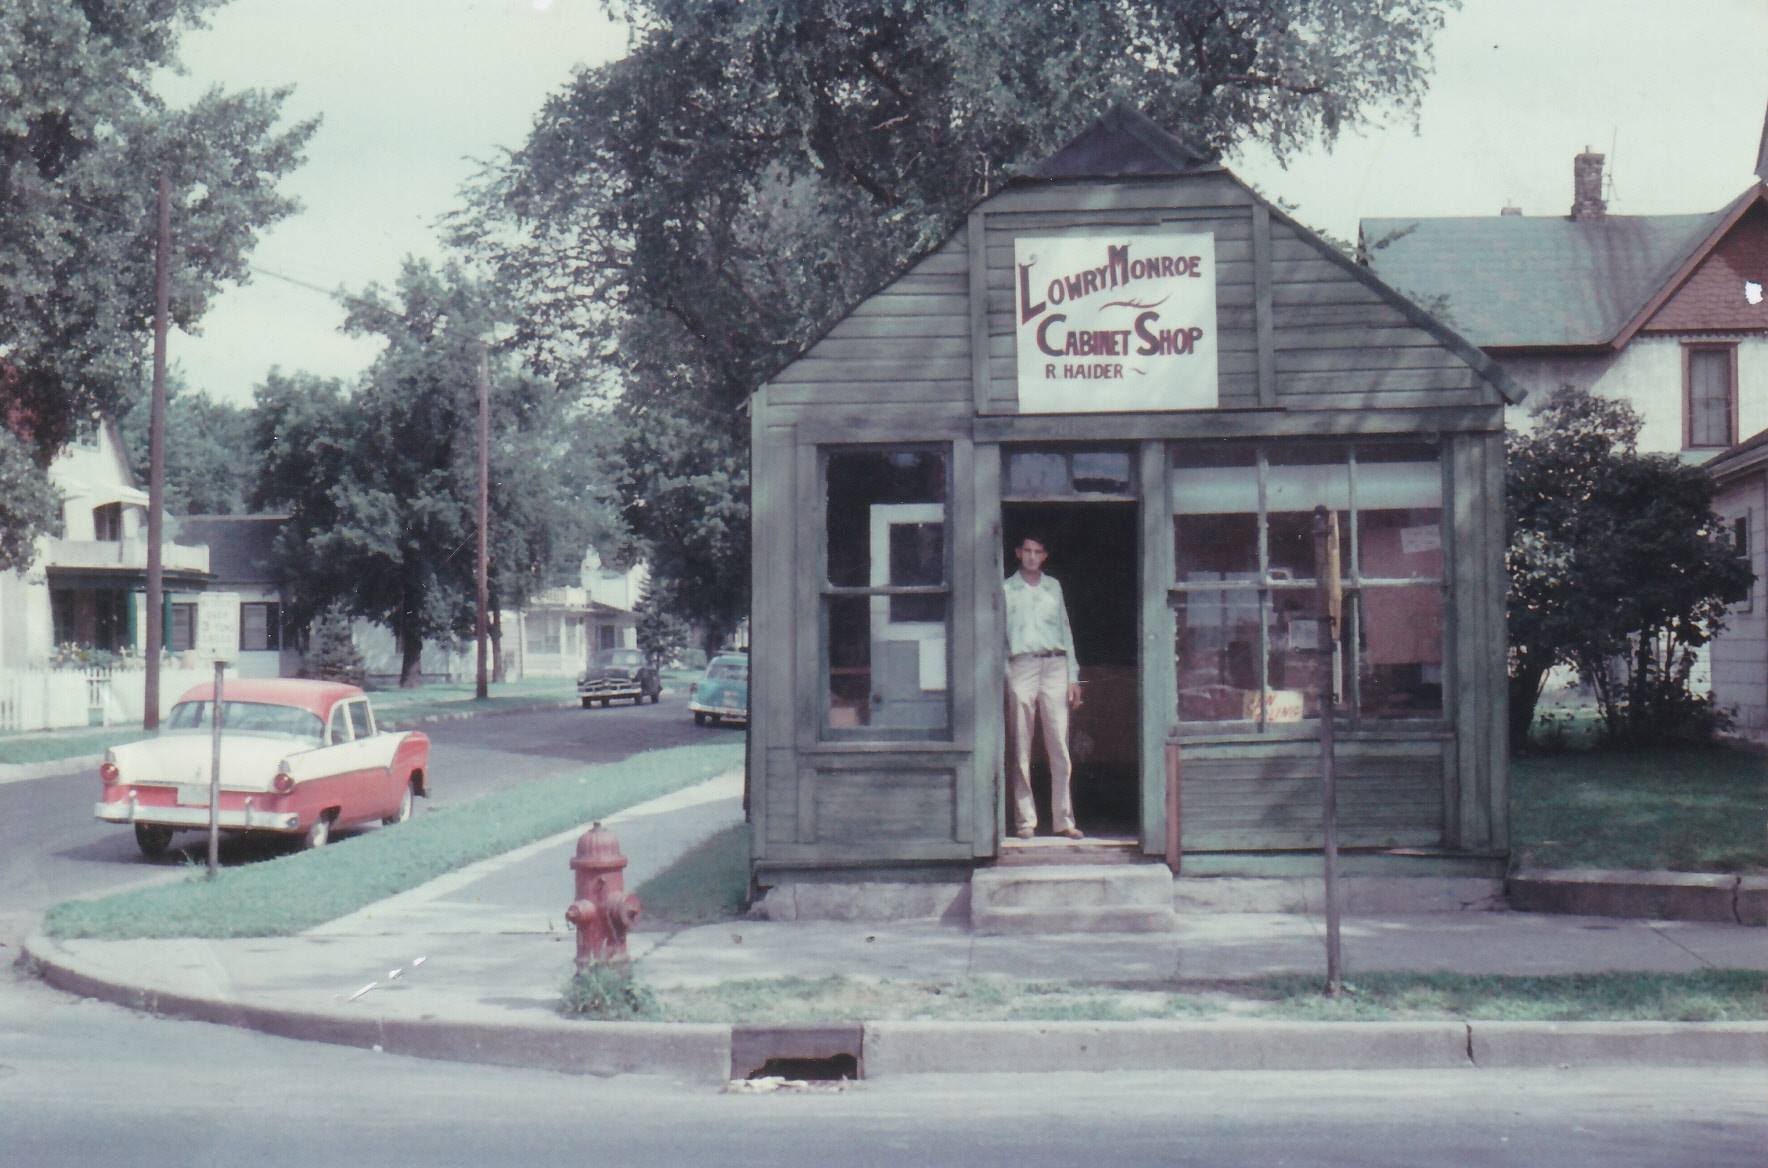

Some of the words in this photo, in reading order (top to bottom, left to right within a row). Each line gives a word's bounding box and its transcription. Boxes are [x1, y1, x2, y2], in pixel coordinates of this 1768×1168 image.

[1018, 260, 1109, 326] LOWRY
[1107, 243, 1202, 291] MONROE
[1036, 313, 1131, 357] CABINET
[1134, 310, 1203, 356] SHOP
[1063, 364, 1124, 379] HAIDER
